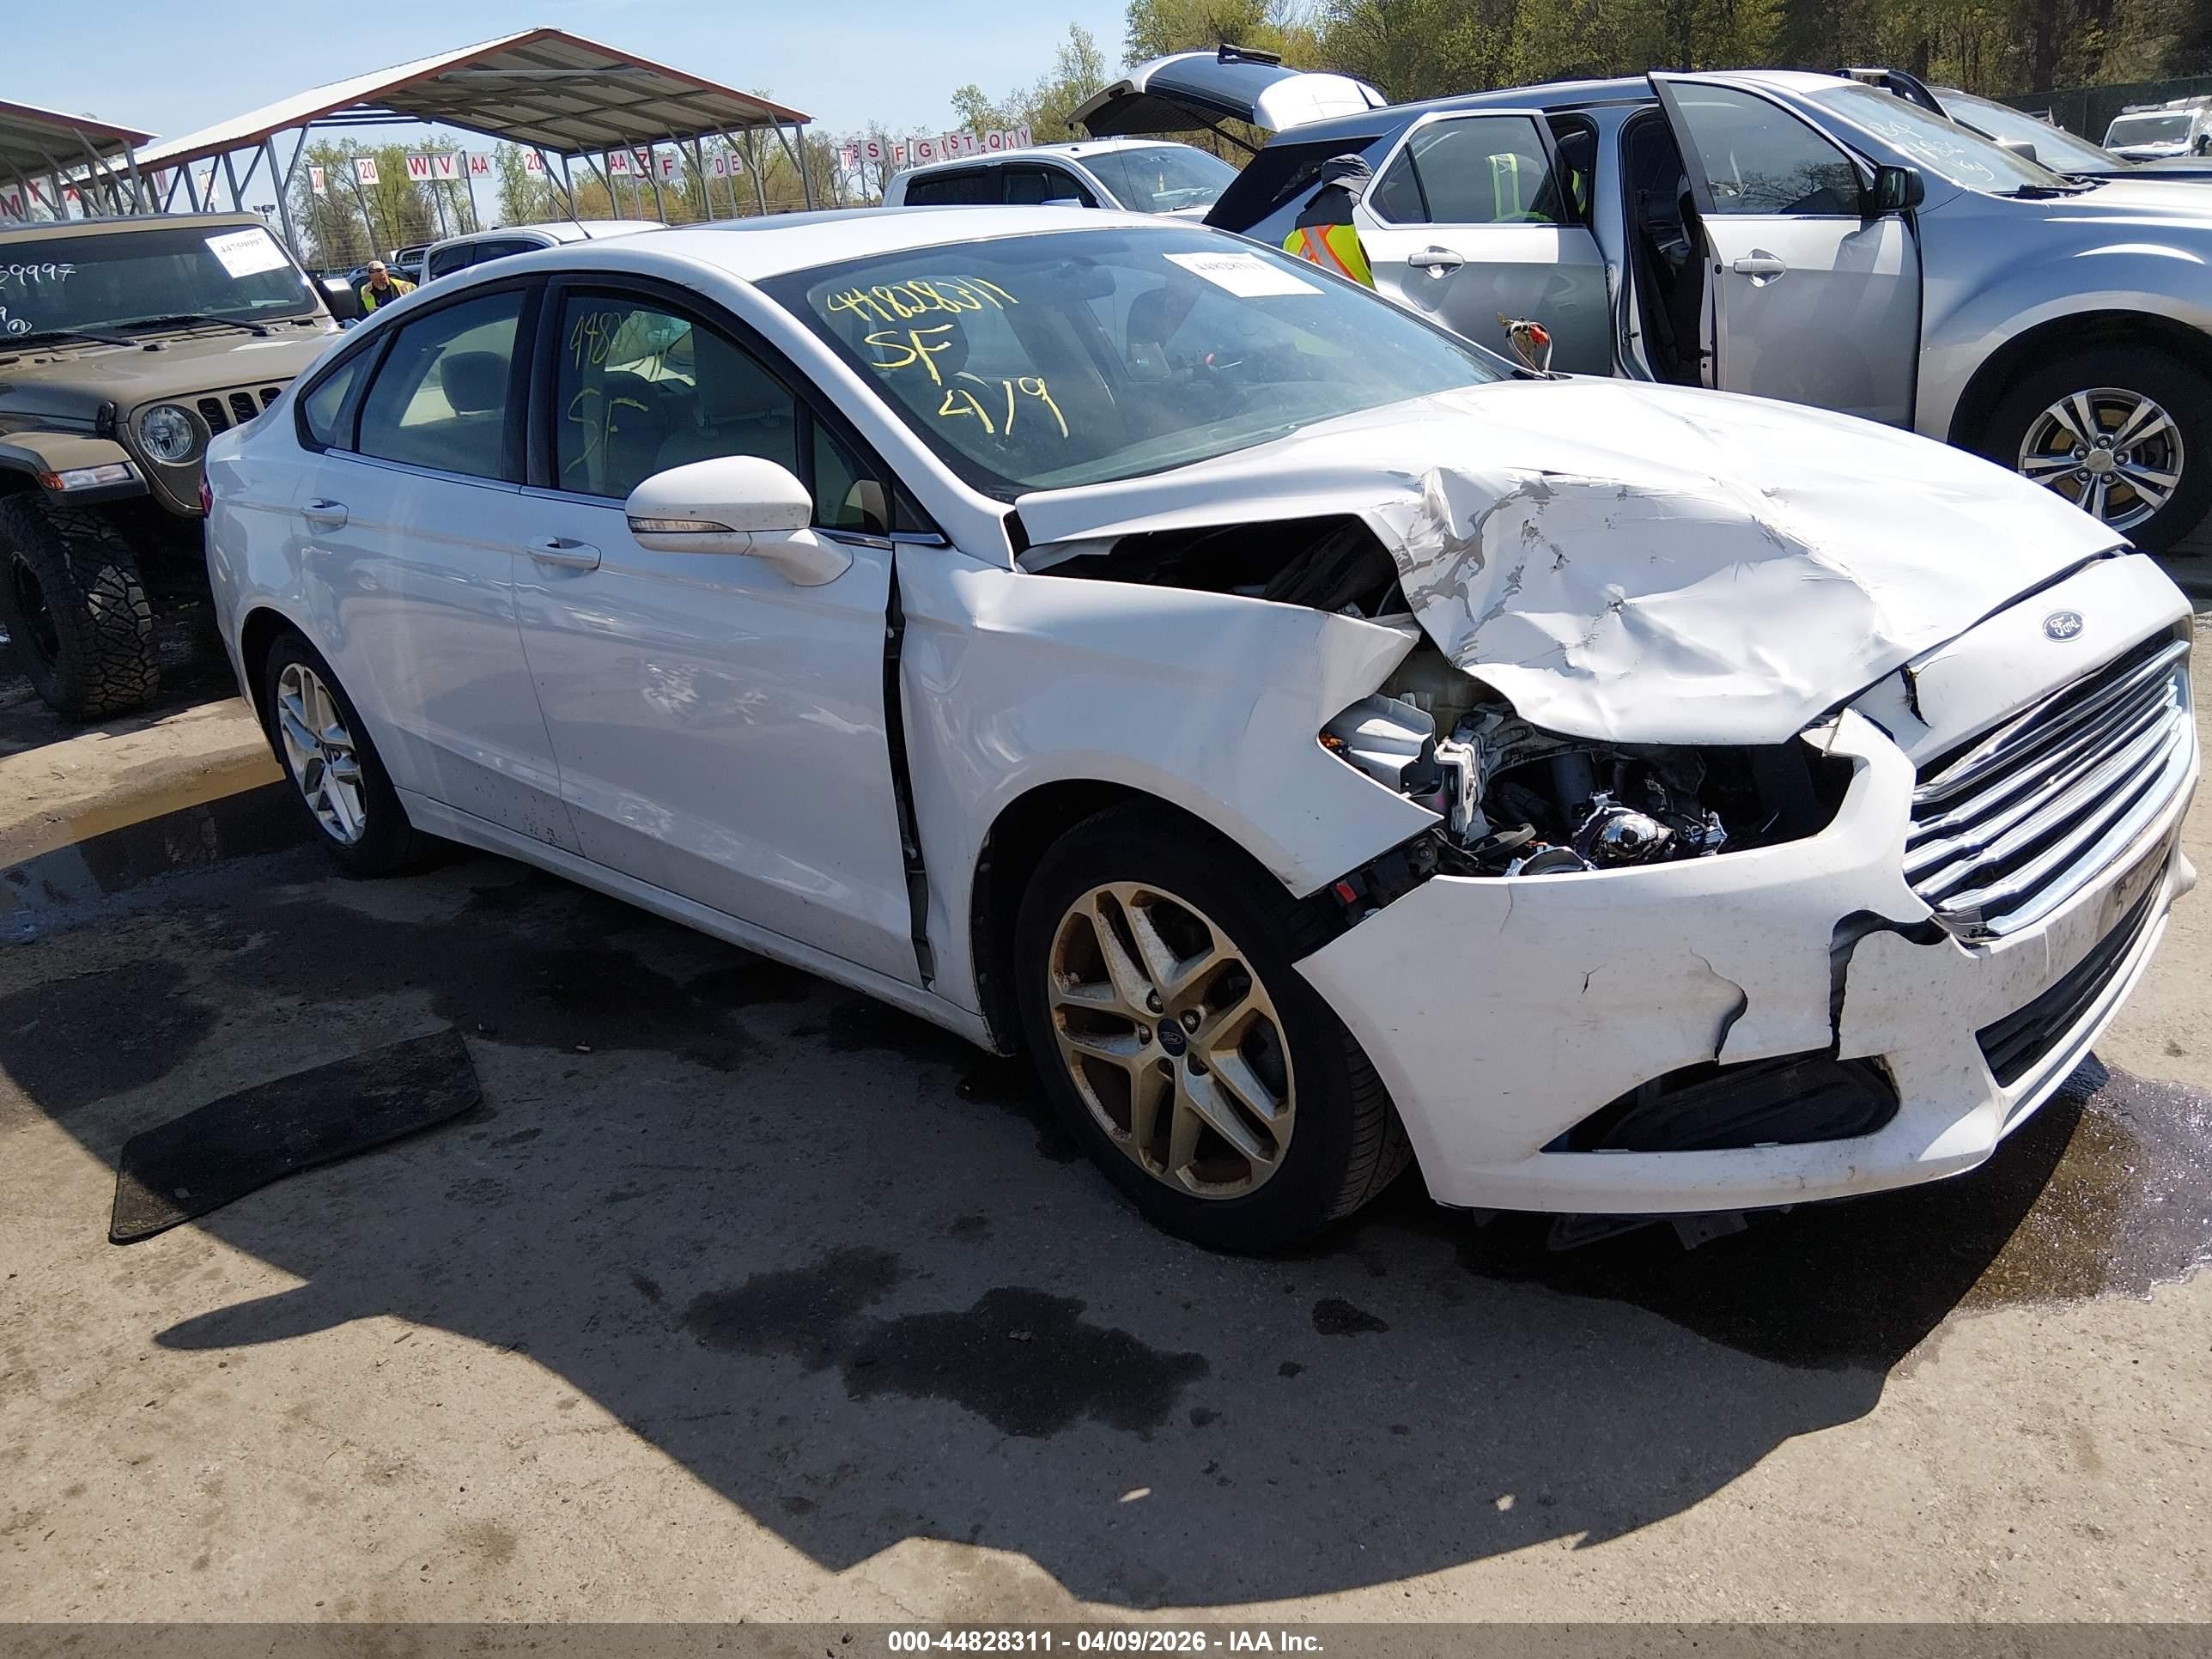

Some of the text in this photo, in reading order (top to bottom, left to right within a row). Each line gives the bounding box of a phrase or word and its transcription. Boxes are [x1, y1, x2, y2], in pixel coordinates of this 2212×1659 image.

[951, 136, 958, 149] S
[963, 137, 972, 149] T
[989, 135, 1000, 149] Q
[1007, 136, 1014, 149] X
[1021, 130, 1028, 144] Y
[867, 143, 878, 157] S
[896, 147, 904, 161] F
[919, 143, 931, 157] G
[408, 158, 427, 175] W
[439, 157, 450, 173] V
[472, 156, 489, 173] AA
[526, 154, 542, 170] 20
[610, 154, 628, 170] AA
[663, 160, 673, 175] F
[715, 159, 724, 173] D
[732, 155, 740, 170] E
[360, 161, 375, 179] 20
[313, 170, 322, 188] 20
[865, 324, 954, 386] SF
[2050, 617, 2081, 636] Ford
